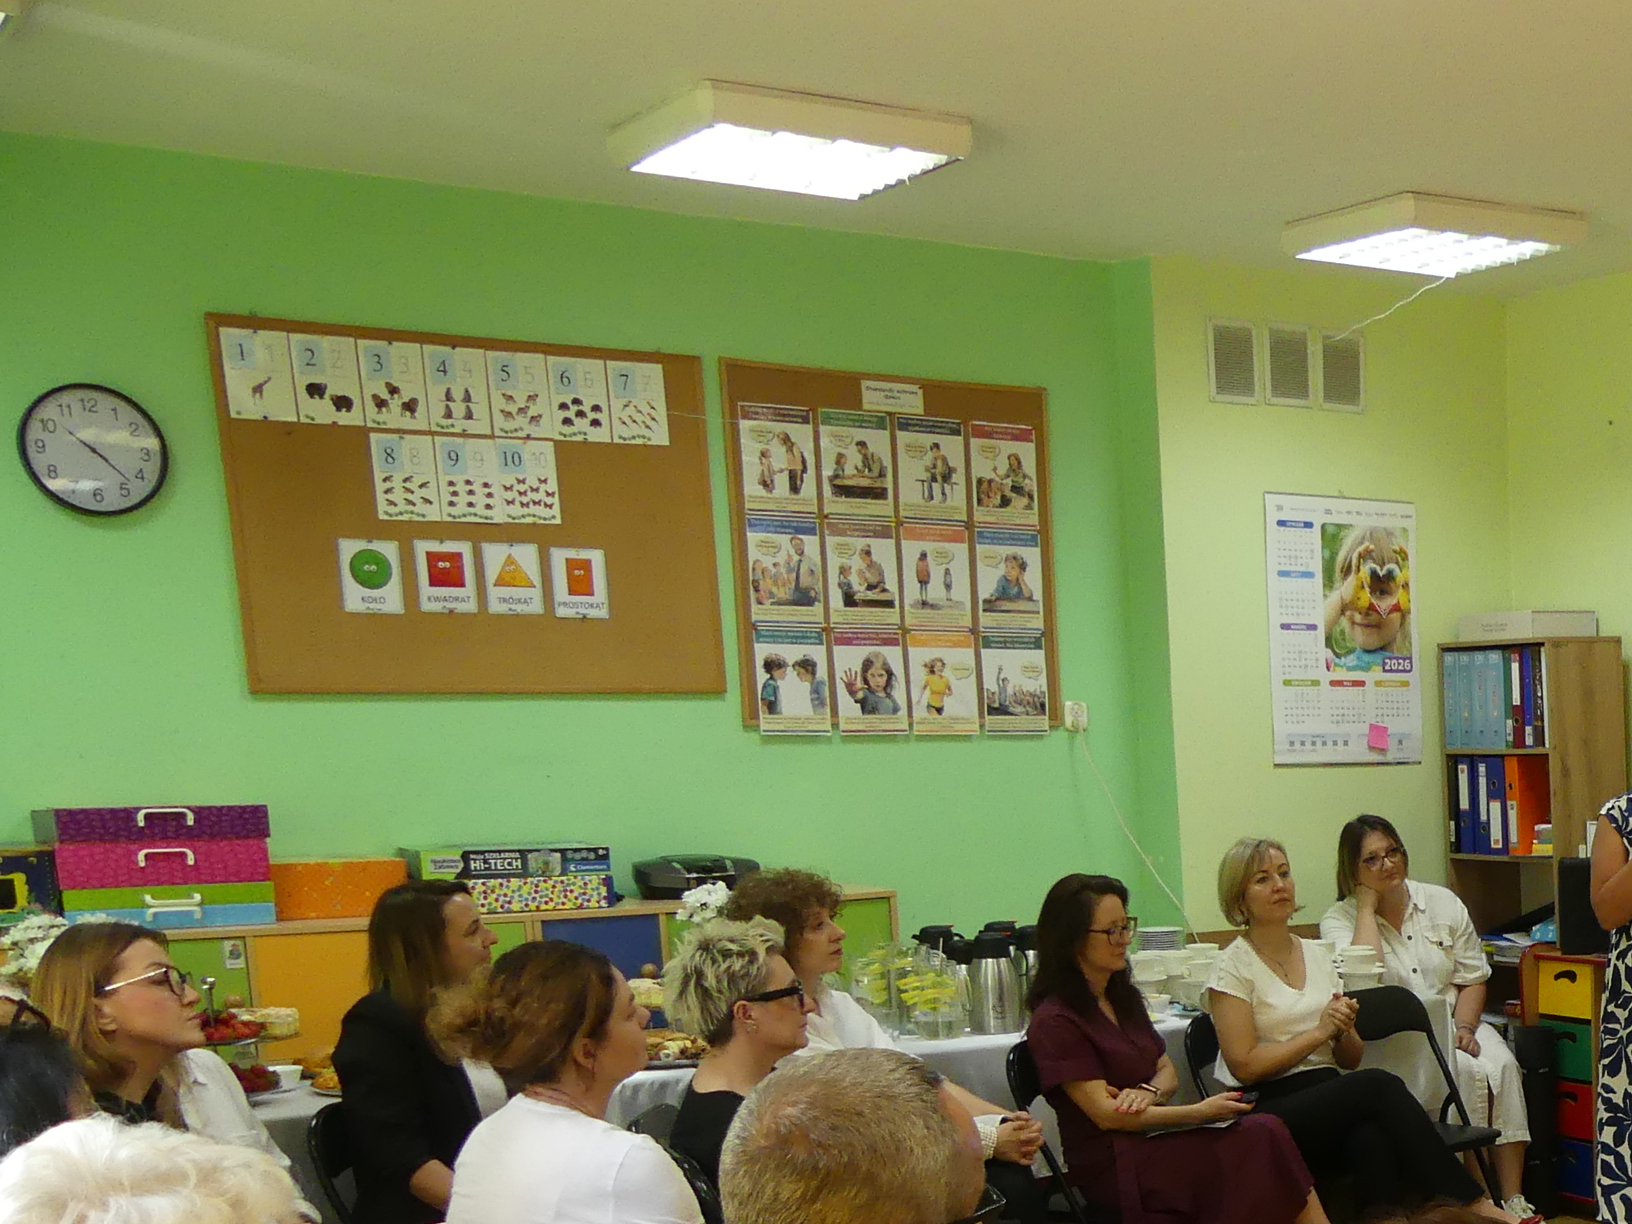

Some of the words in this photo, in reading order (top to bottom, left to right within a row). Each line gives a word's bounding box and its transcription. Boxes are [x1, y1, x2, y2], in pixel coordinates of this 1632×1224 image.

[238, 343, 245, 361] 1
[304, 348, 317, 366] 2
[372, 354, 383, 372] 3
[436, 360, 449, 376] 4
[501, 365, 511, 382] 5
[560, 369, 571, 388] 6
[619, 374, 629, 391] 7
[57, 403, 73, 418] 11
[80, 398, 99, 414] 12
[111, 406, 119, 421] 1
[40, 418, 57, 433] 10
[129, 422, 140, 437] 2
[34, 438, 46, 454] 9
[140, 447, 151, 462] 3
[384, 446, 396, 464] 8
[448, 449, 459, 467] 9
[503, 450, 522, 467] 10
[47, 464, 58, 479] 8
[135, 468, 145, 482] 4
[93, 488, 105, 503] 6
[120, 482, 131, 498] 5
[427, 595, 471, 603] KWADRAT
[1384, 659, 1411, 670] 2026
[470, 859, 521, 870] Hi-TECH
